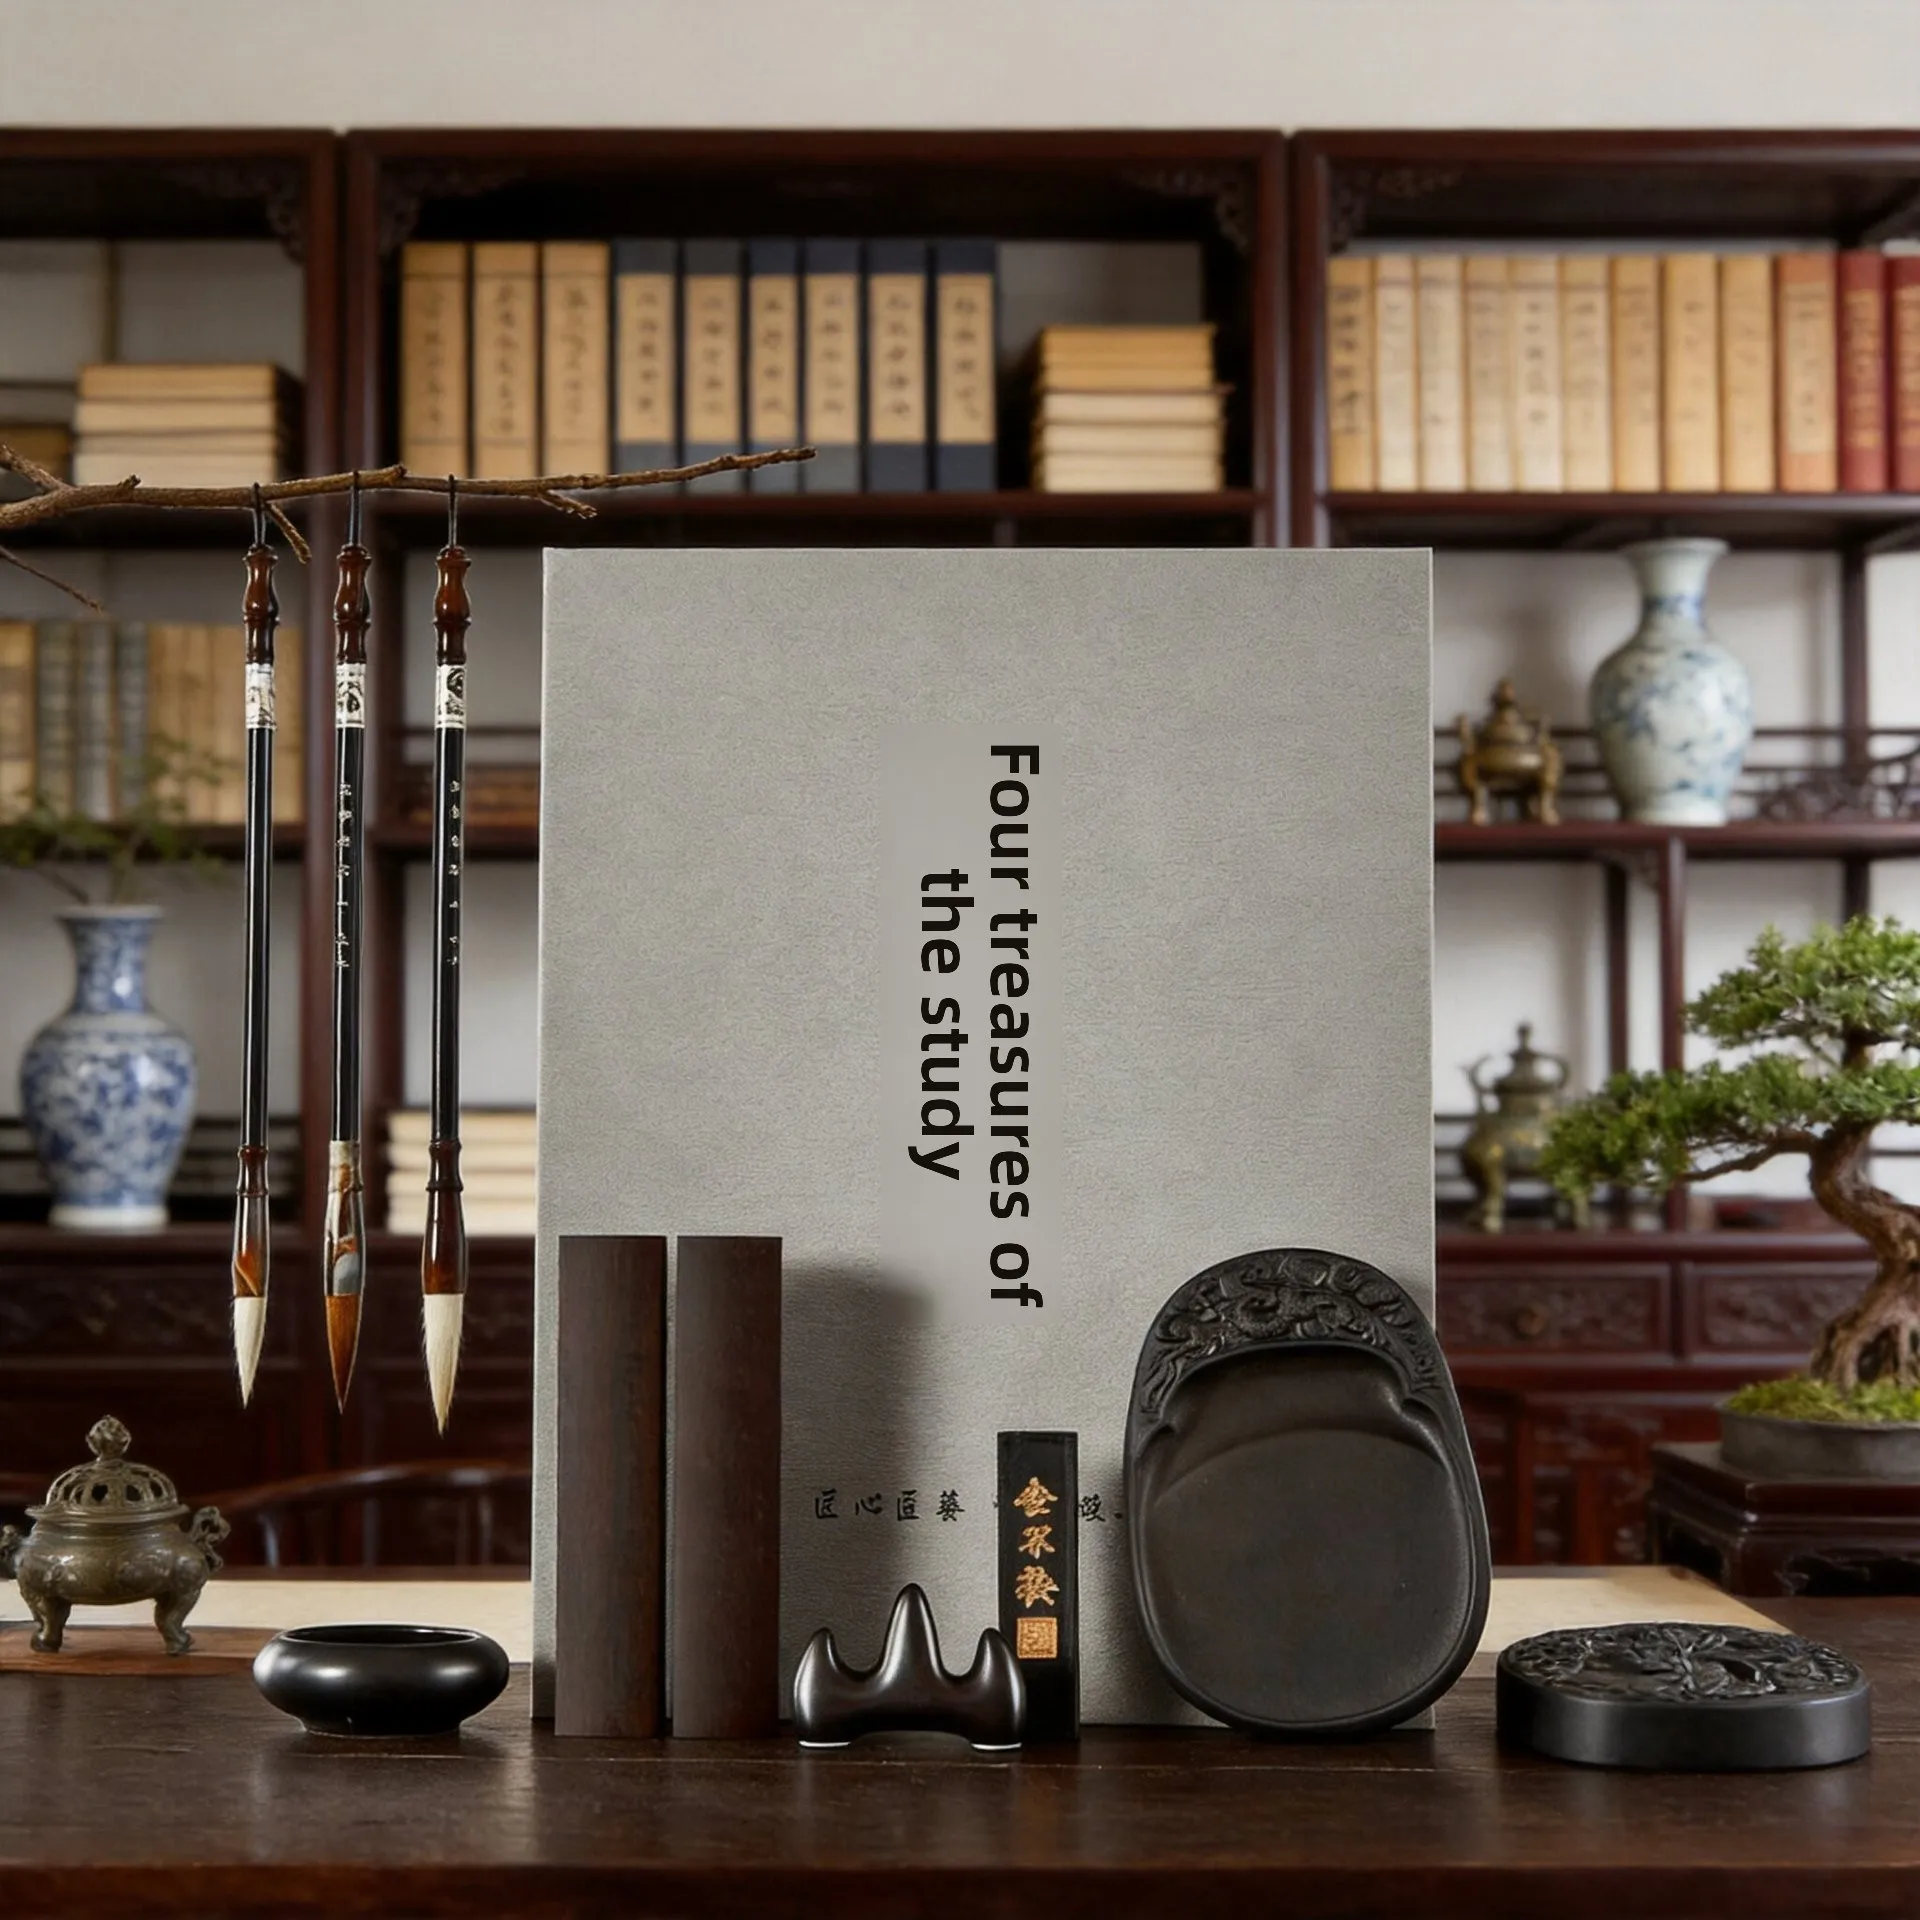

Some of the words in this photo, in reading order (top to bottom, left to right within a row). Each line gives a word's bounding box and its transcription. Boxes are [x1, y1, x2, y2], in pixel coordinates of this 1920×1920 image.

[990, 746, 1039, 889] Four
[921, 869, 974, 973] the
[908, 998, 974, 1180] study
[990, 909, 1037, 1218] treasures
[990, 1243, 1043, 1307] of
